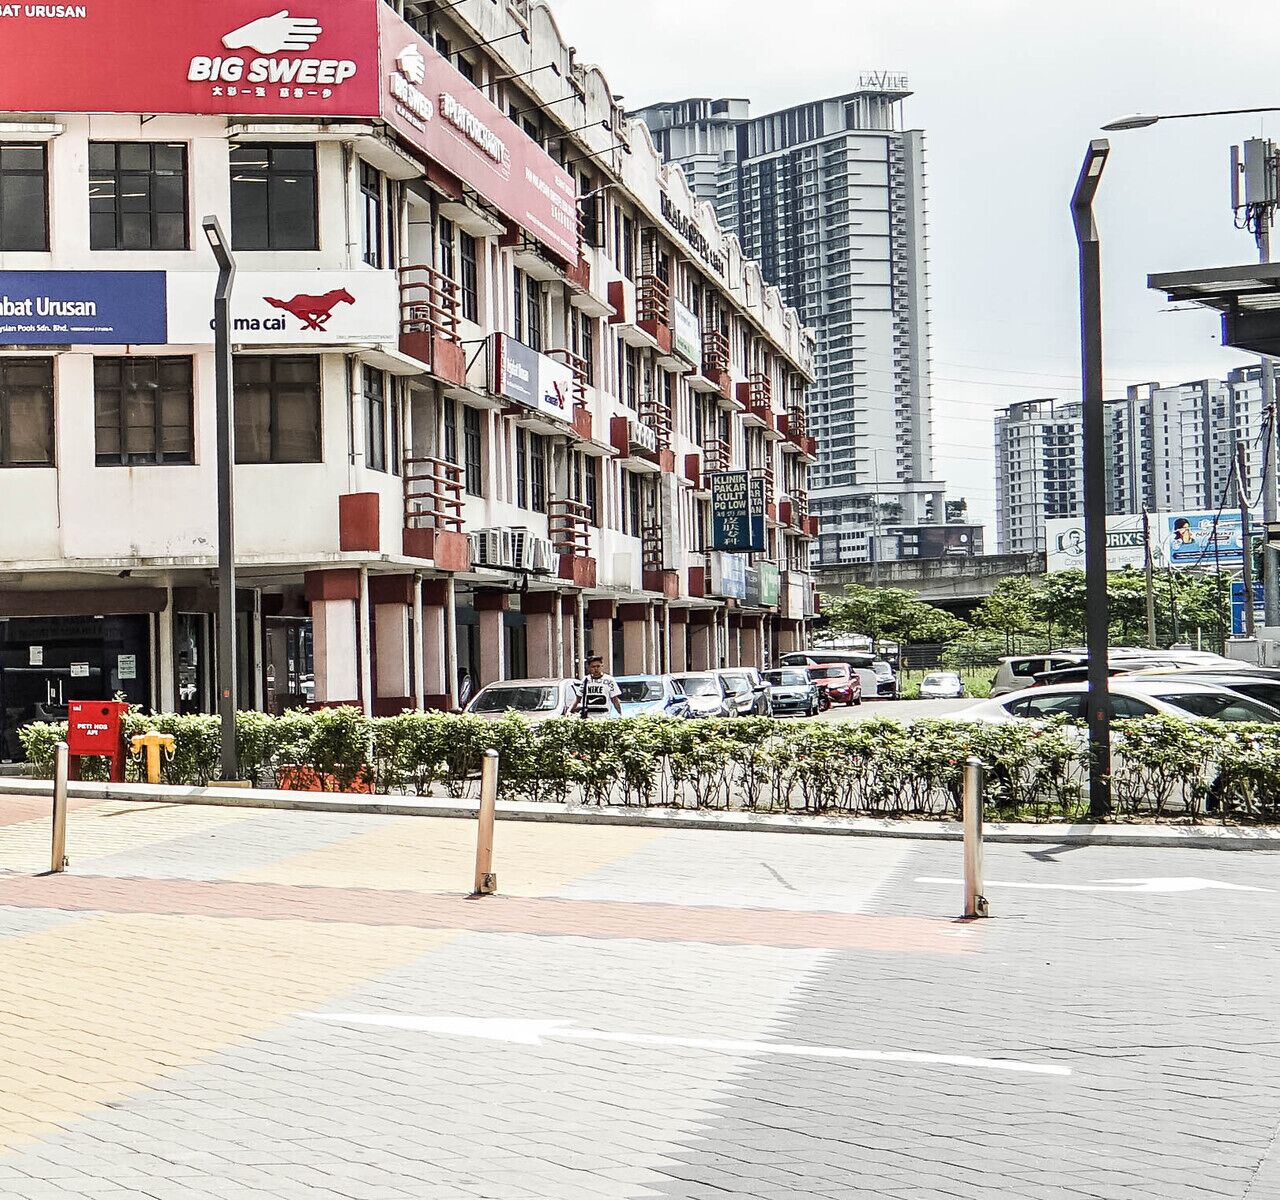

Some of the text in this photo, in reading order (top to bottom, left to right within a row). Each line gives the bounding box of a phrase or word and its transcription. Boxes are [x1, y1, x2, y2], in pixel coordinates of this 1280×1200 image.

[24, 5, 87, 18] URUSAN
[186, 56, 357, 85] BIG SWEEP
[36, 297, 97, 316] Urusan
[233, 318, 261, 331] ma
[262, 314, 286, 331] cai
[713, 474, 746, 485] KLINIK
[713, 483, 747, 494] PAKAR
[716, 492, 745, 502] KULIT
[714, 500, 747, 511] PG LOW
[587, 685, 603, 694] NIKE
